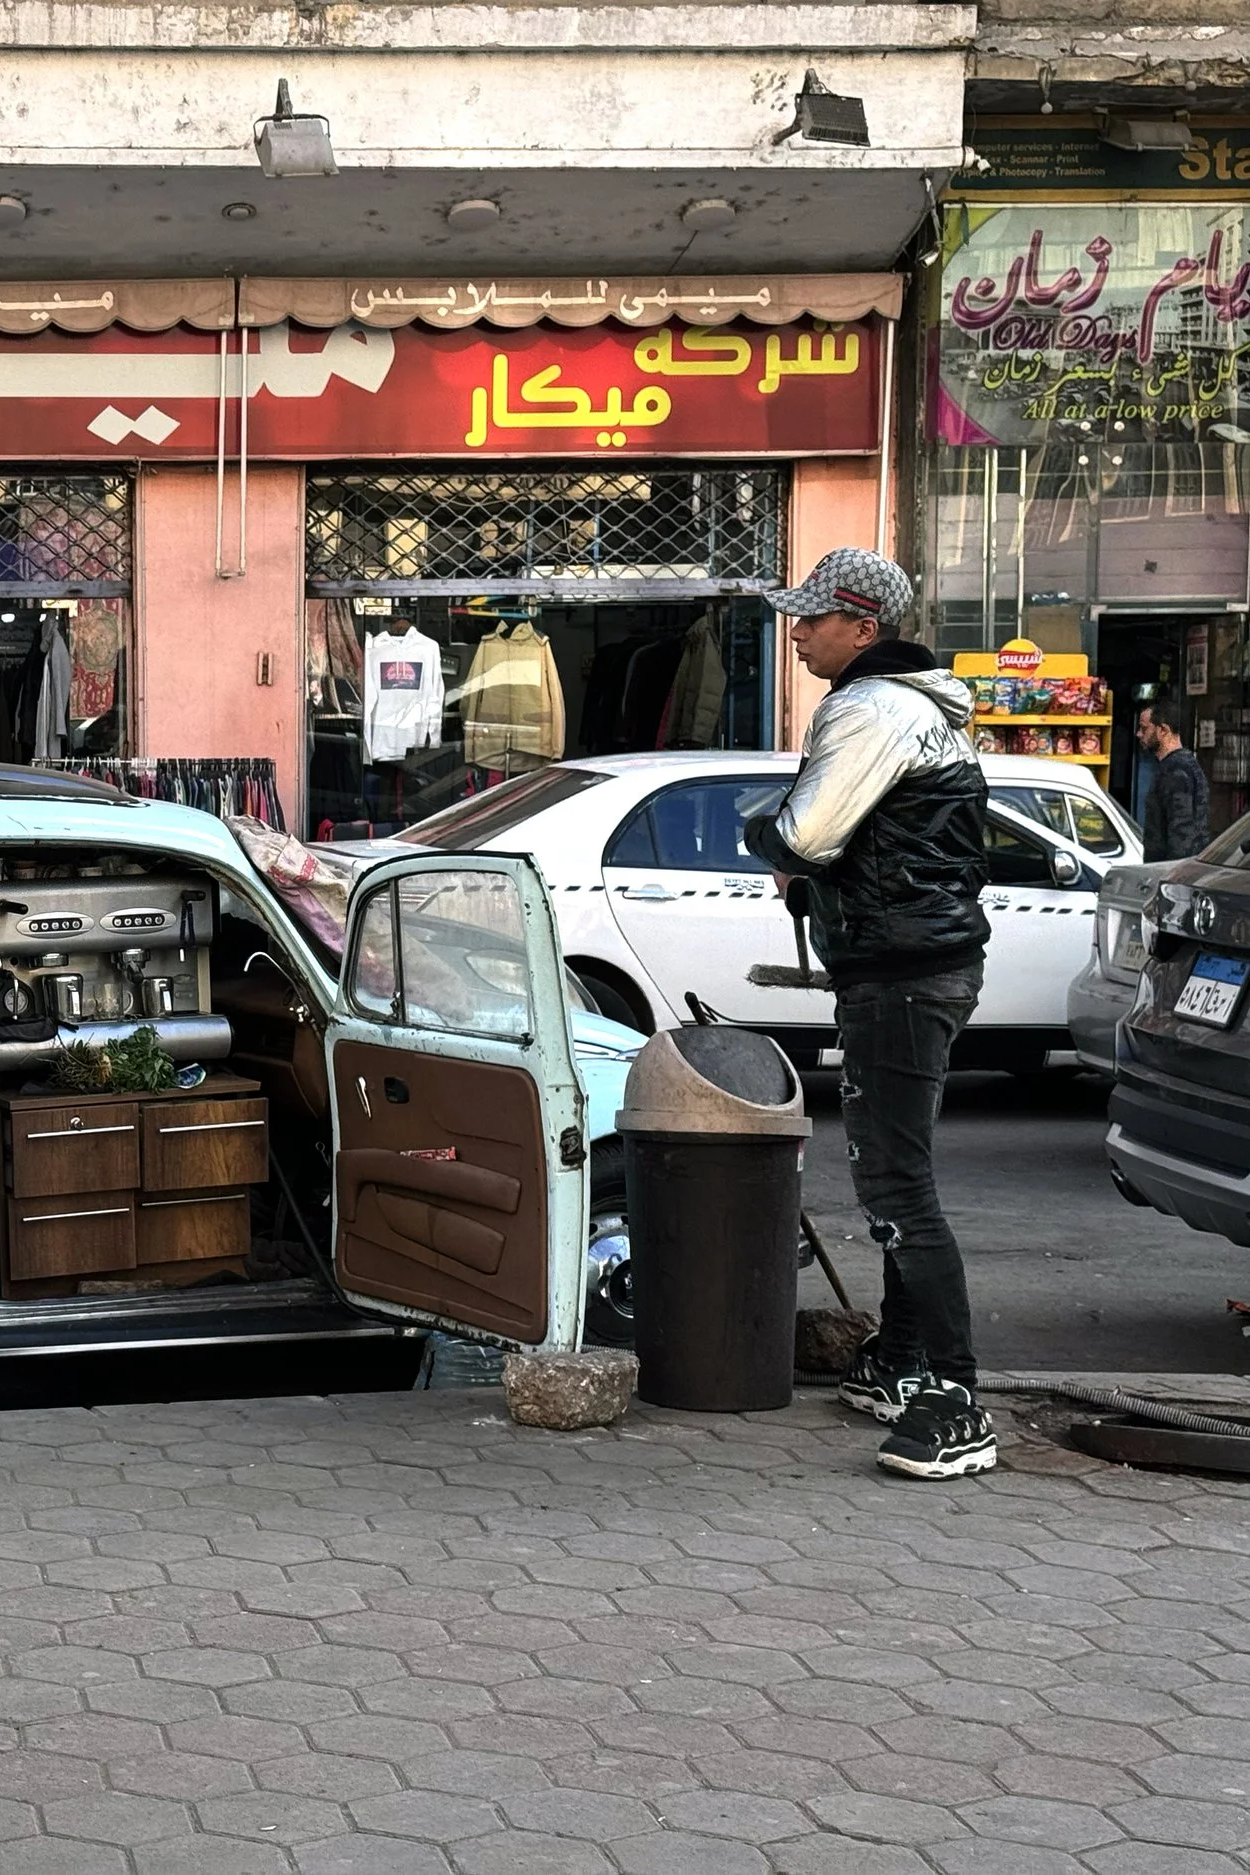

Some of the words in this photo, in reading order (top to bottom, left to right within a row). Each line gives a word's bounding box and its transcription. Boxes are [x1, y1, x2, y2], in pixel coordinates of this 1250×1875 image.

[969, 143, 1011, 153] omputer
[999, 167, 1047, 178] Photocopy
[1055, 167, 1106, 176] Translation
[952, 229, 1113, 330] زمان
[350, 280, 608, 317] للملابس
[619, 286, 772, 320] ميمى
[993, 316, 1049, 350] Old
[1056, 315, 1138, 363] Days
[983, 350, 1043, 389] زمان
[1043, 360, 1117, 396] بسعر
[464, 353, 671, 448] ميكار
[1023, 400, 1057, 419] All
[1064, 402, 1086, 418] at
[1094, 404, 1108, 418] a
[1116, 400, 1156, 418] low
[1162, 402, 1224, 422] price
